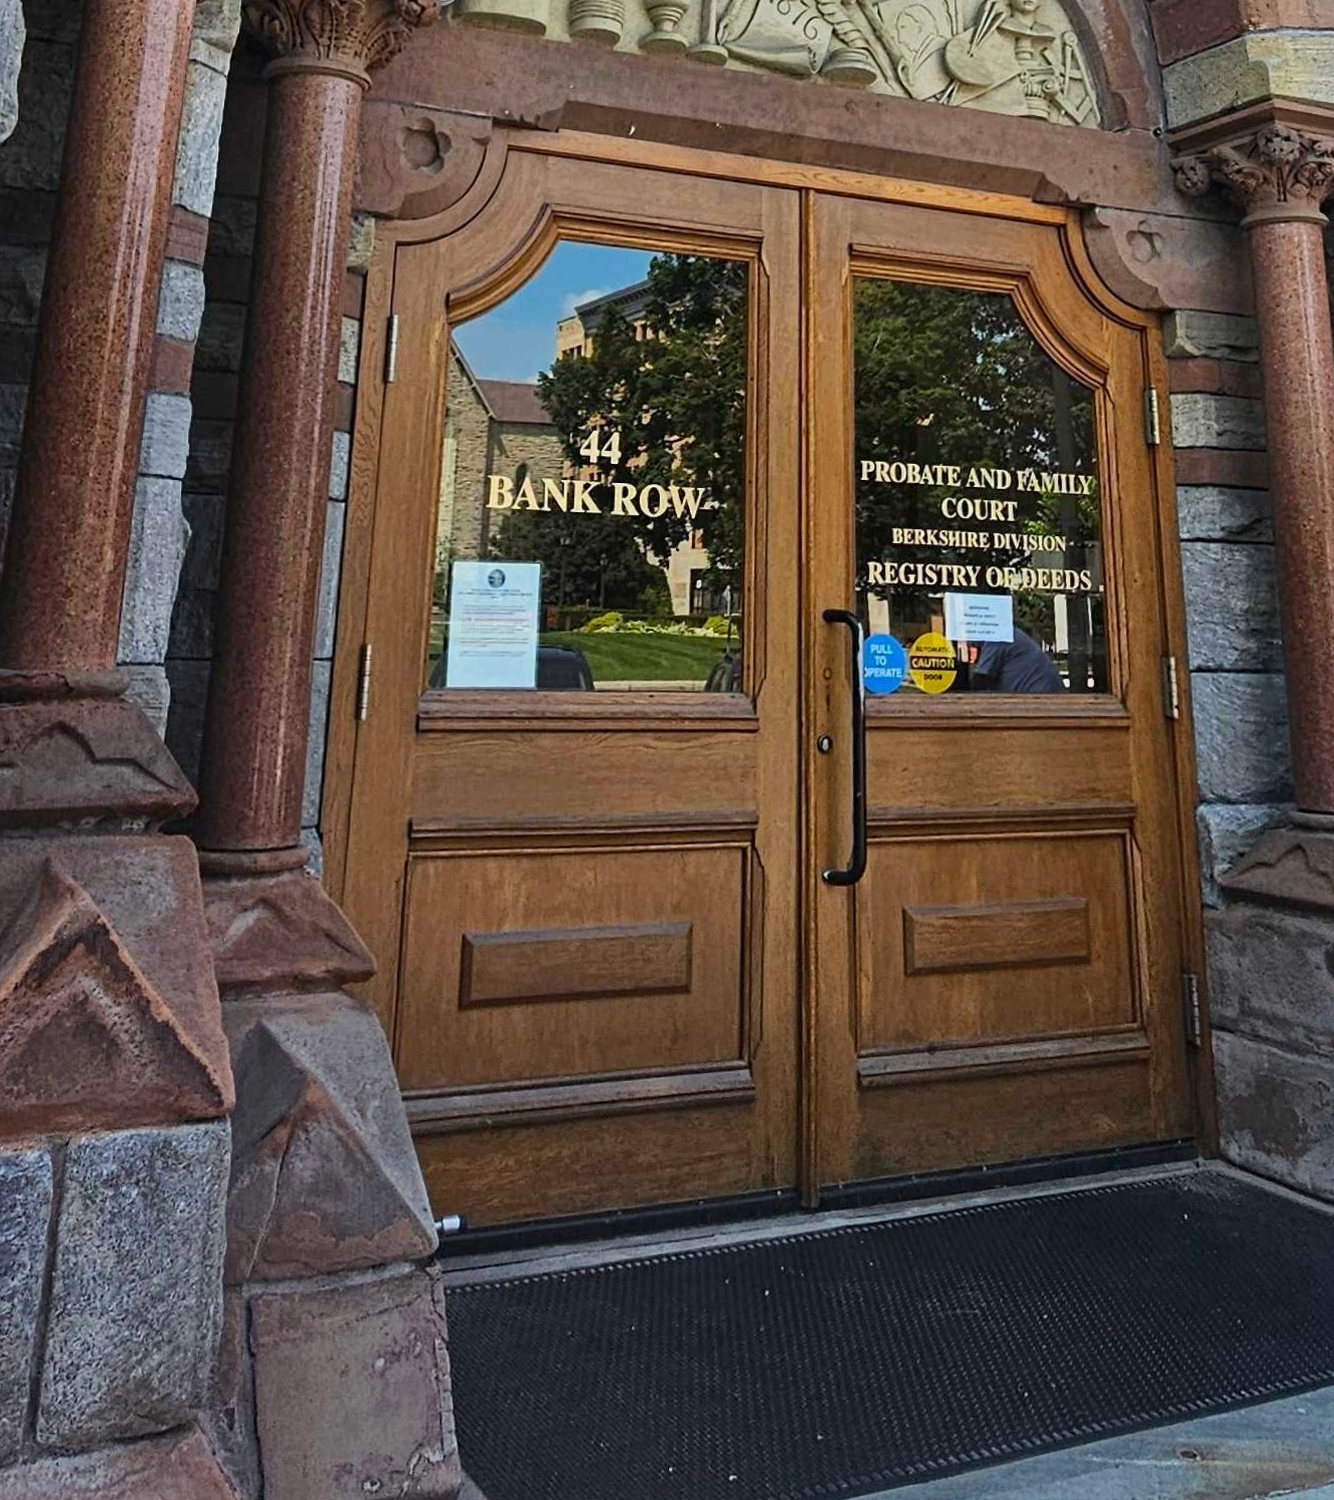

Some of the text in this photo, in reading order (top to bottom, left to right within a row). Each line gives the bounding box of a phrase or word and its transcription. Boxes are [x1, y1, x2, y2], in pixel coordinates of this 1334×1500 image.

[578, 430, 622, 465] 44
[860, 460, 1093, 495] PROBATE AND FAMILY
[485, 474, 705, 520] BANK ROW
[941, 497, 1018, 521] COURT
[892, 528, 1066, 552] BERKSHIRE DIVISION
[867, 561, 1092, 590] REGISTRY OF DEEDS
[870, 644, 894, 654] PULL
[874, 655, 887, 666] TO
[912, 658, 955, 669] CAUTION
